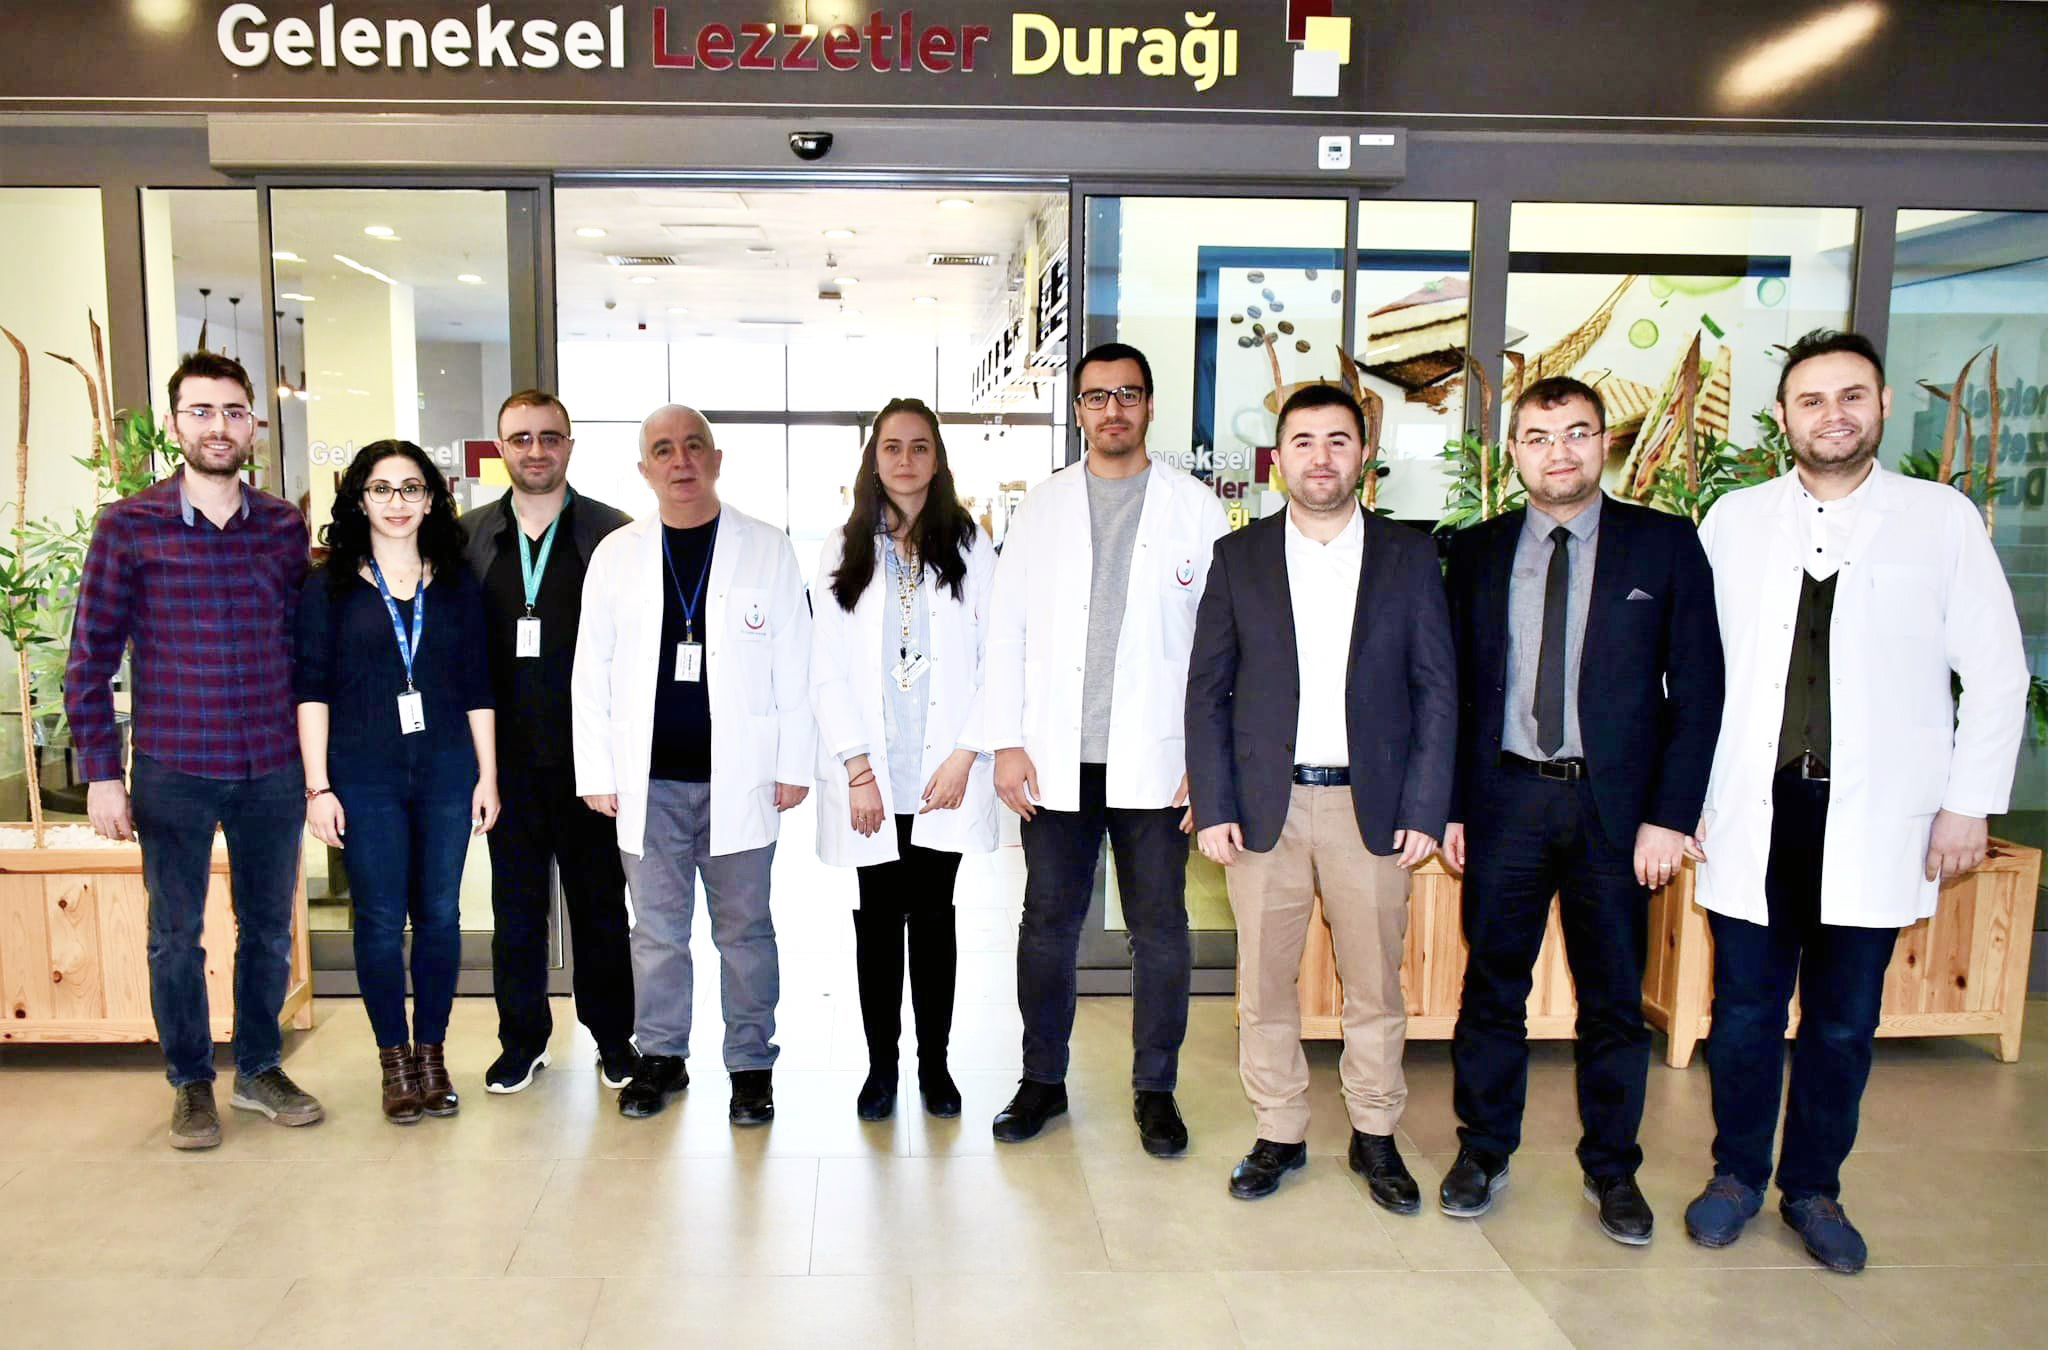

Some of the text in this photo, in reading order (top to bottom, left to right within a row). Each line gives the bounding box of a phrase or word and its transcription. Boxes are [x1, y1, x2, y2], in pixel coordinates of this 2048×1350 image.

[216, 3, 1238, 92] Geleneksel Lezzetler Durağı
